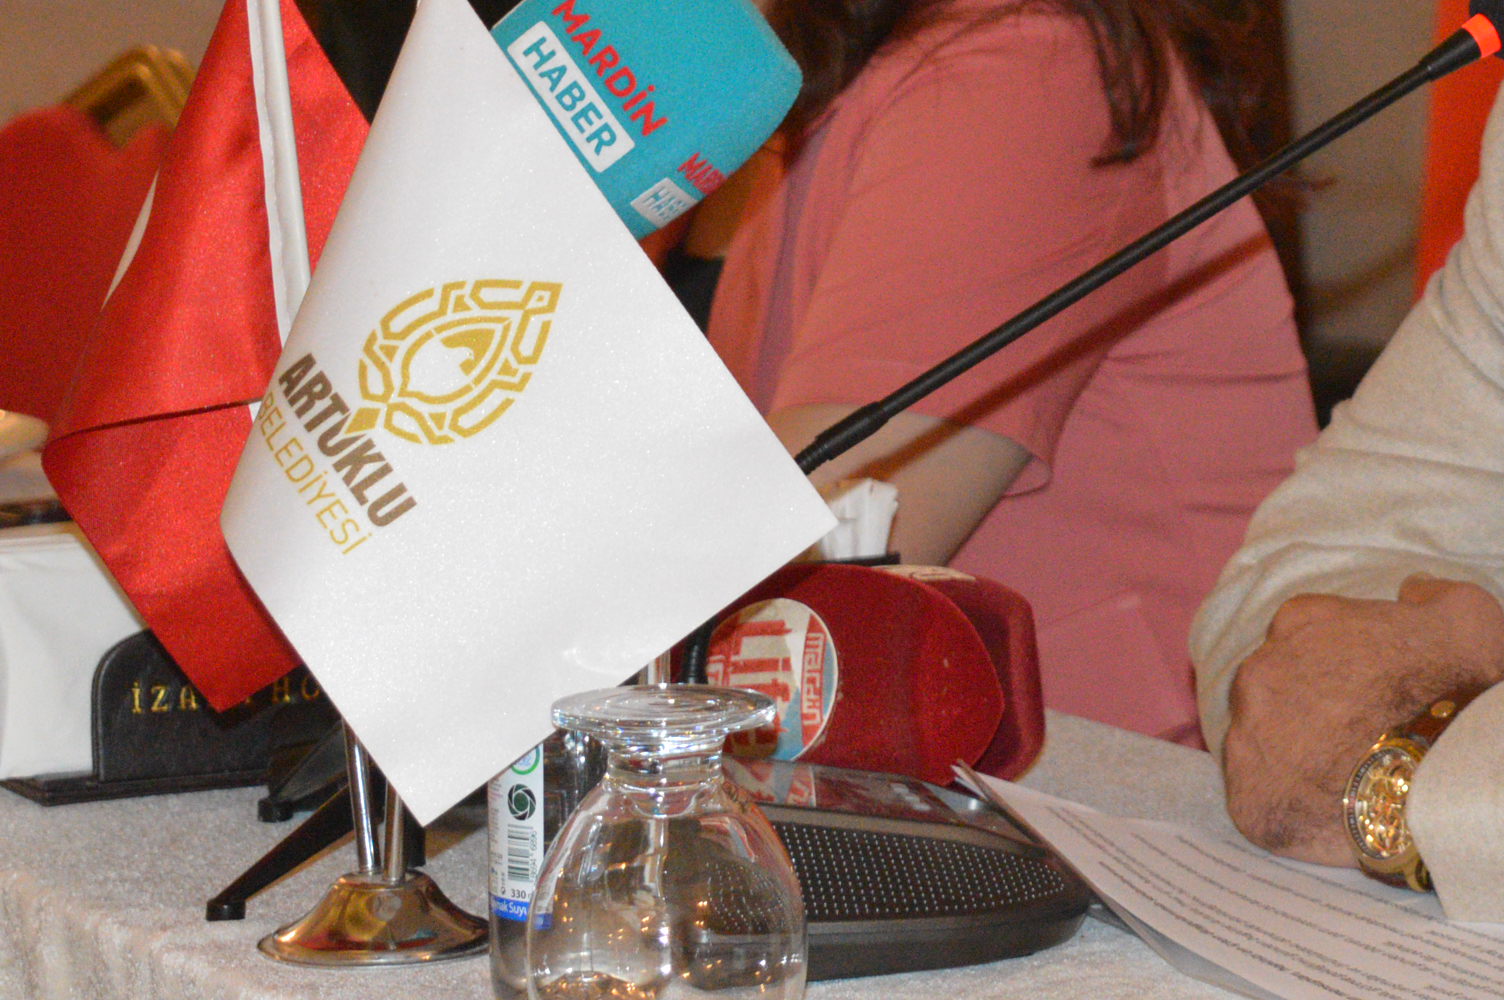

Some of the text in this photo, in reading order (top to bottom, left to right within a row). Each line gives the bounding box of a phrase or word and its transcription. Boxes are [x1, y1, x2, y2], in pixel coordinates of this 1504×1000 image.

[522, 36, 617, 157] HABER
[278, 352, 418, 528] ARTUKLU
[511, 888, 527, 899] 330
